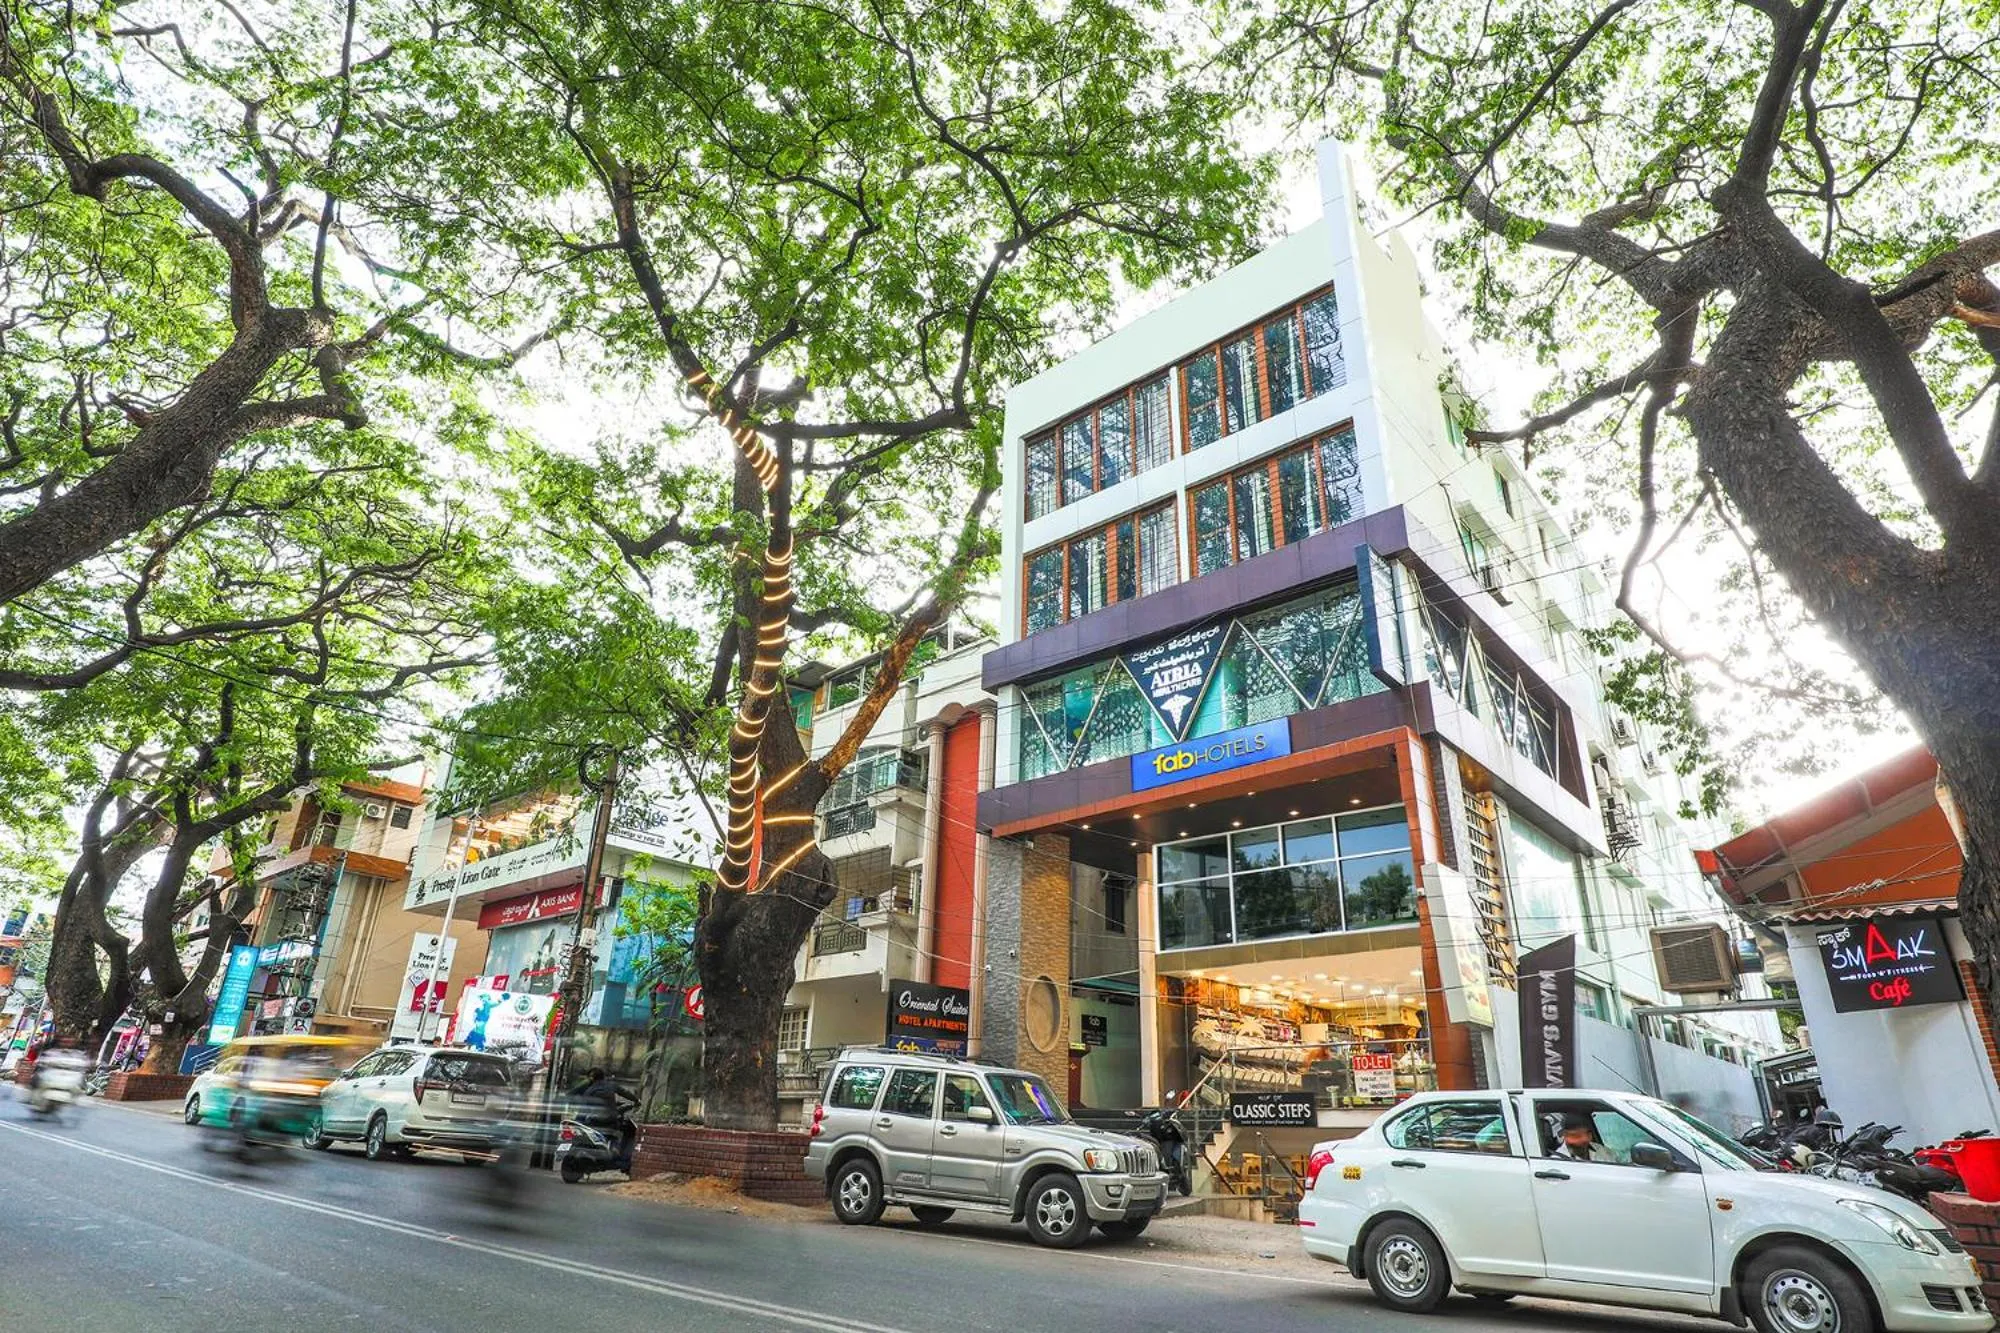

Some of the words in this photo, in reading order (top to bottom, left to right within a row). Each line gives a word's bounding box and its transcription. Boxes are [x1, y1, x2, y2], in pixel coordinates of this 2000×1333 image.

[1151, 662, 1203, 690] ATRIA
[1152, 677, 1202, 698] HEALTHCARE
[461, 872, 480, 885] Lion
[481, 866, 500, 880] Gate
[541, 897, 556, 908] AXIS
[557, 892, 576, 904] BANK
[1832, 923, 1935, 972] SMAAK
[899, 990, 939, 1011] Oriental
[1539, 970, 1559, 1021] GYM
[1869, 977, 1911, 1006] Café
[898, 1014, 921, 1026] HOTEL
[923, 1017, 968, 1032] APARTMENTS
[1354, 1054, 1389, 1069] TO-LET
[1232, 1103, 1276, 1118] CLASSIC
[1278, 1103, 1311, 1118] STEPS
